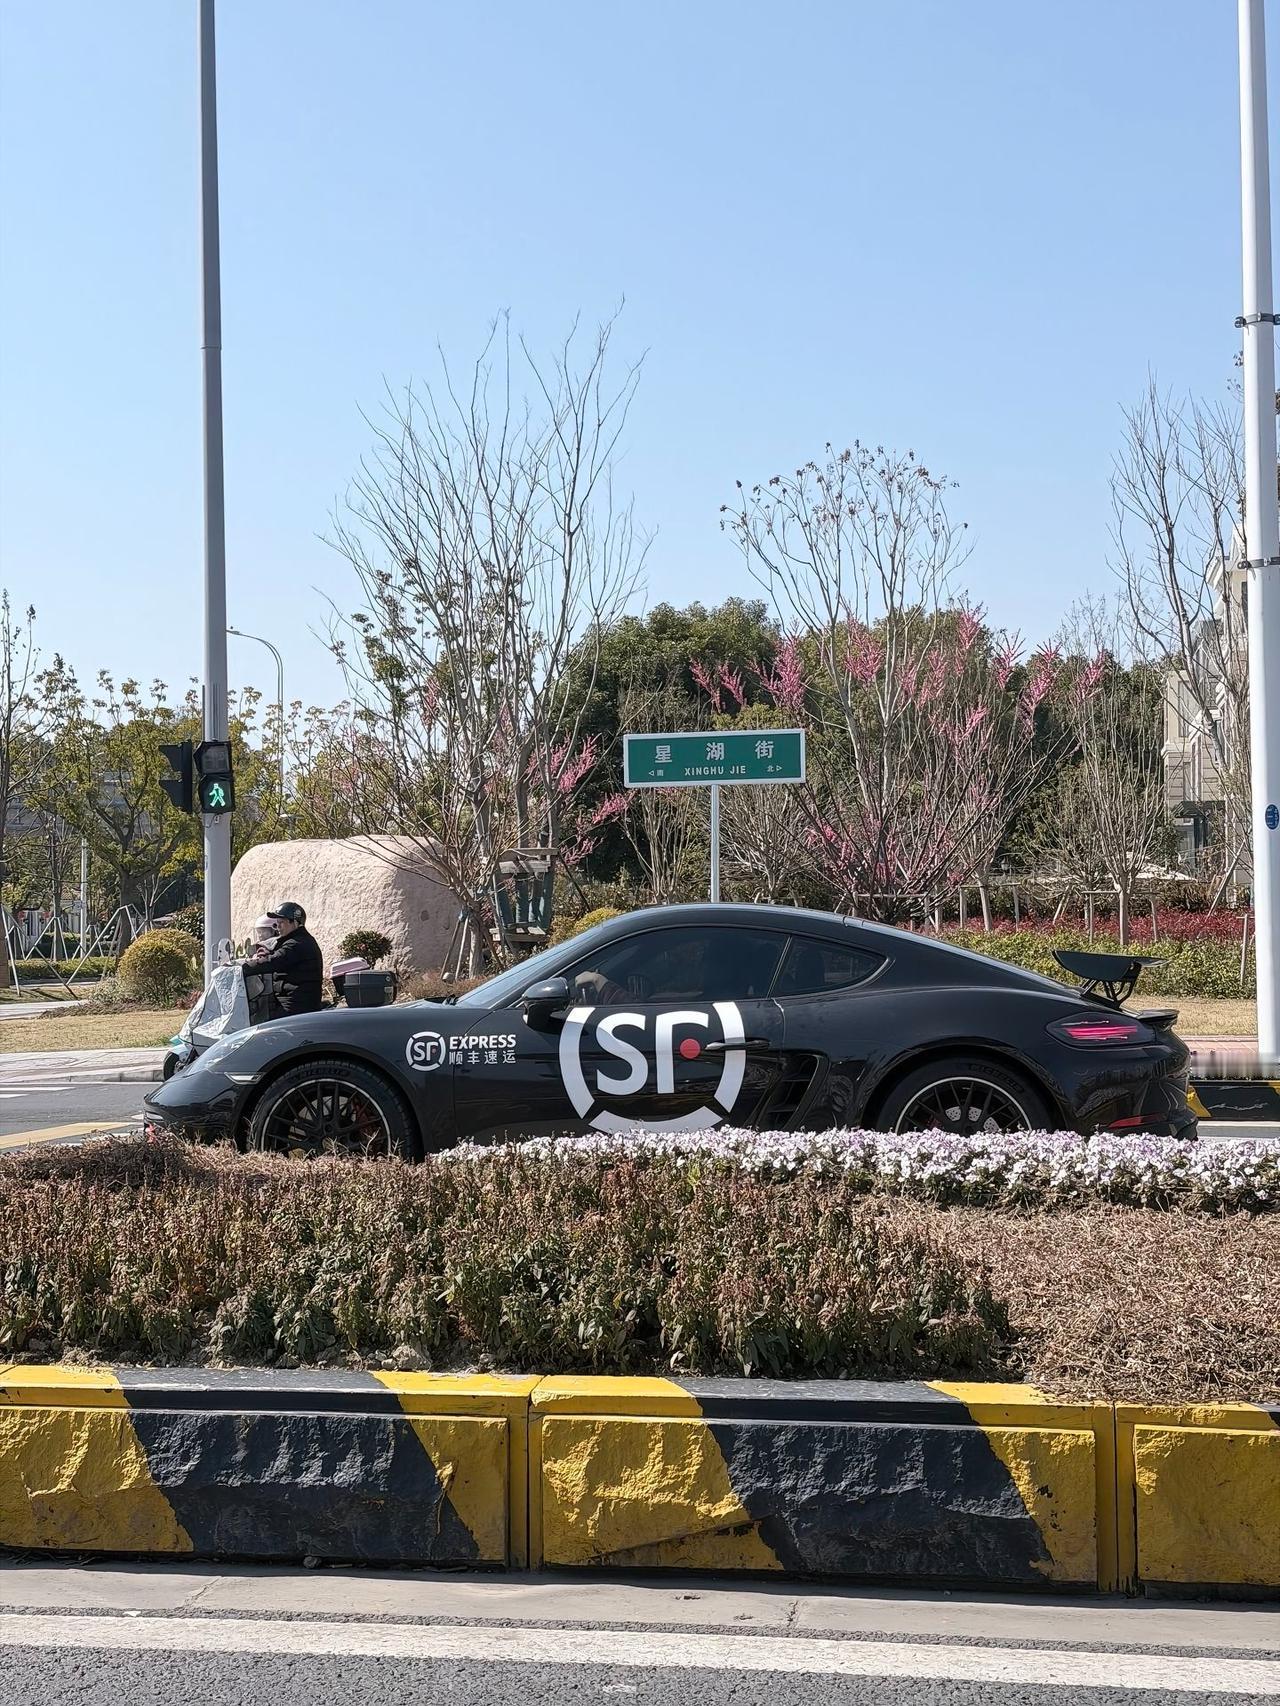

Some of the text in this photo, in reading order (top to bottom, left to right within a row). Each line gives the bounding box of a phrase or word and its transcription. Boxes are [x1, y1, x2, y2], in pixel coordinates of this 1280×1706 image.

[654, 740, 774, 764] 星湖街
[684, 765, 747, 776] XINGHU JIE
[449, 1034, 517, 1050] EXPRESS
[449, 1050, 516, 1065] 顺丰速运
